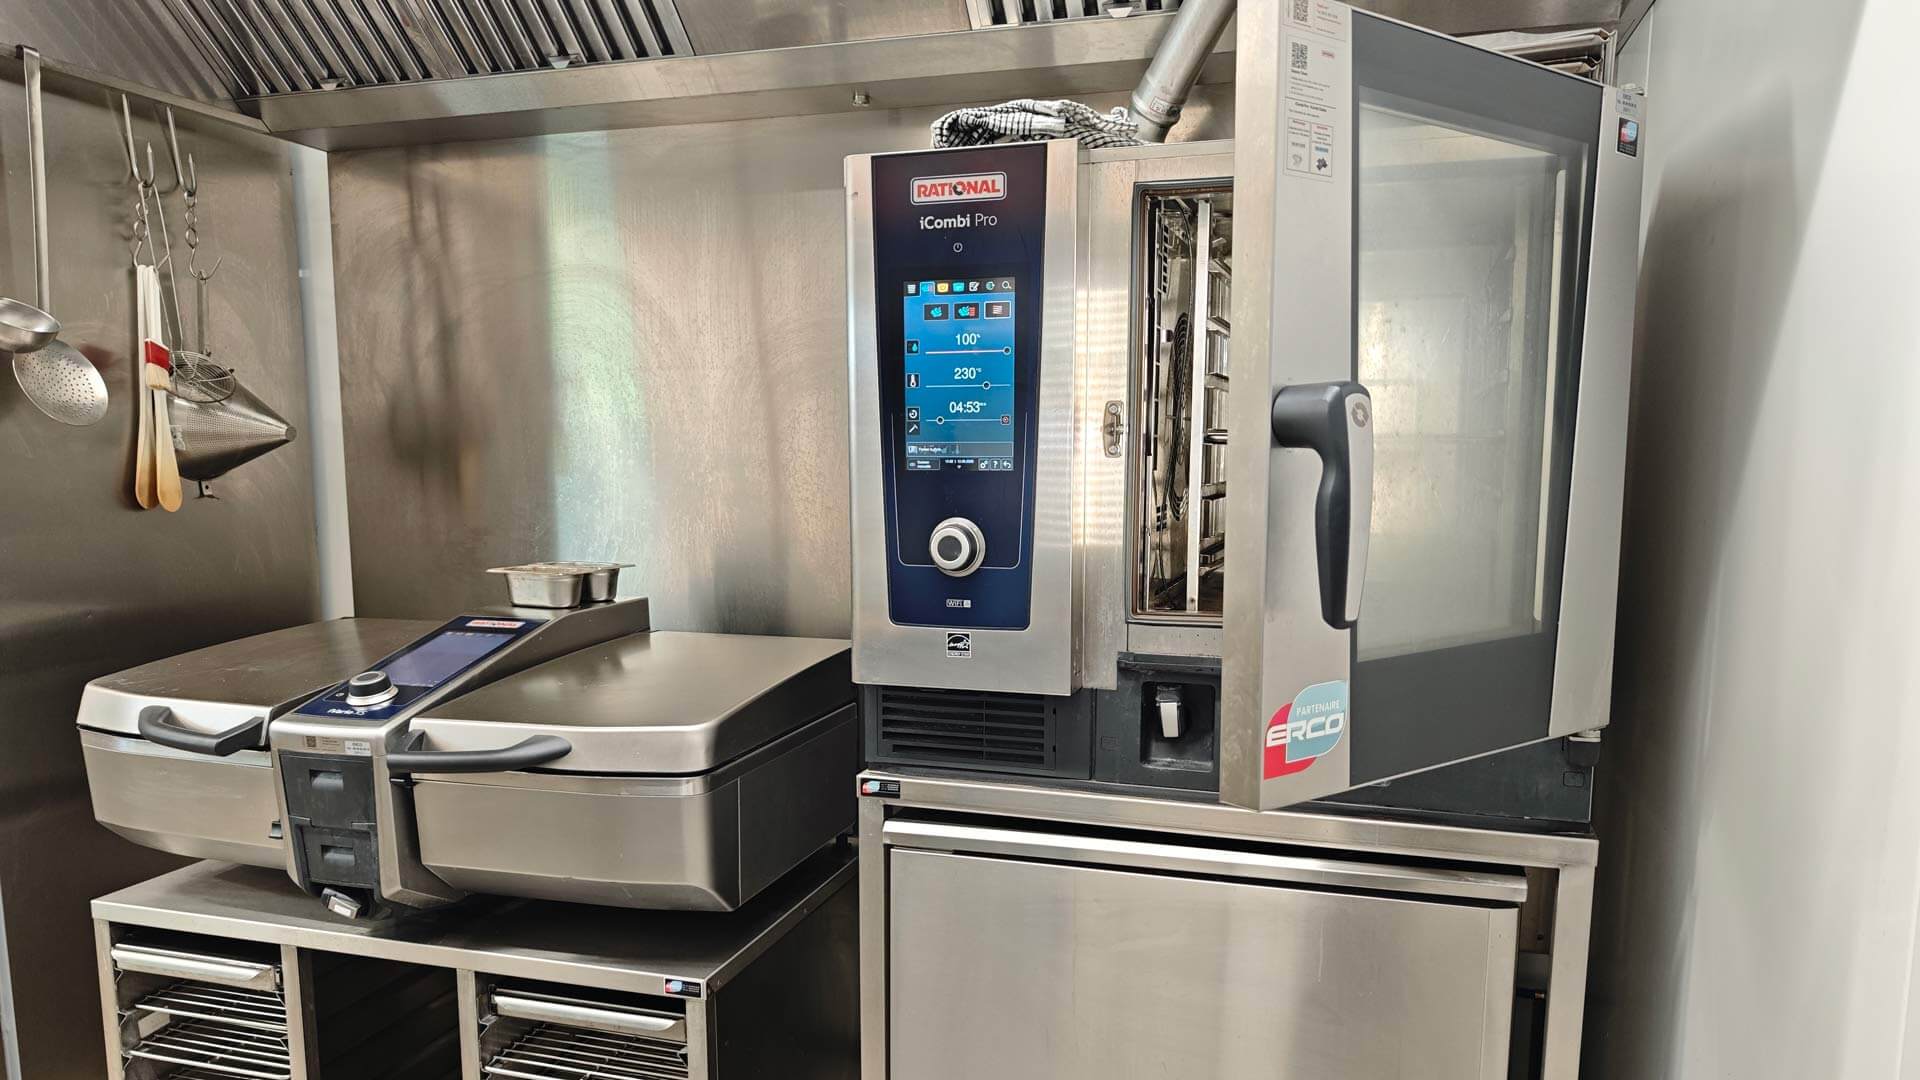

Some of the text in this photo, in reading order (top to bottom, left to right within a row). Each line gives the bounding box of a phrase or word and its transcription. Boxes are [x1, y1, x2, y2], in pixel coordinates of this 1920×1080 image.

[917, 179, 1001, 198] RATIONAL
[920, 213, 998, 230] iCombi Pro
[949, 401, 981, 413] 04:53
[1296, 699, 1340, 716] PARTENAIRE
[1266, 712, 1344, 747] ERCO
